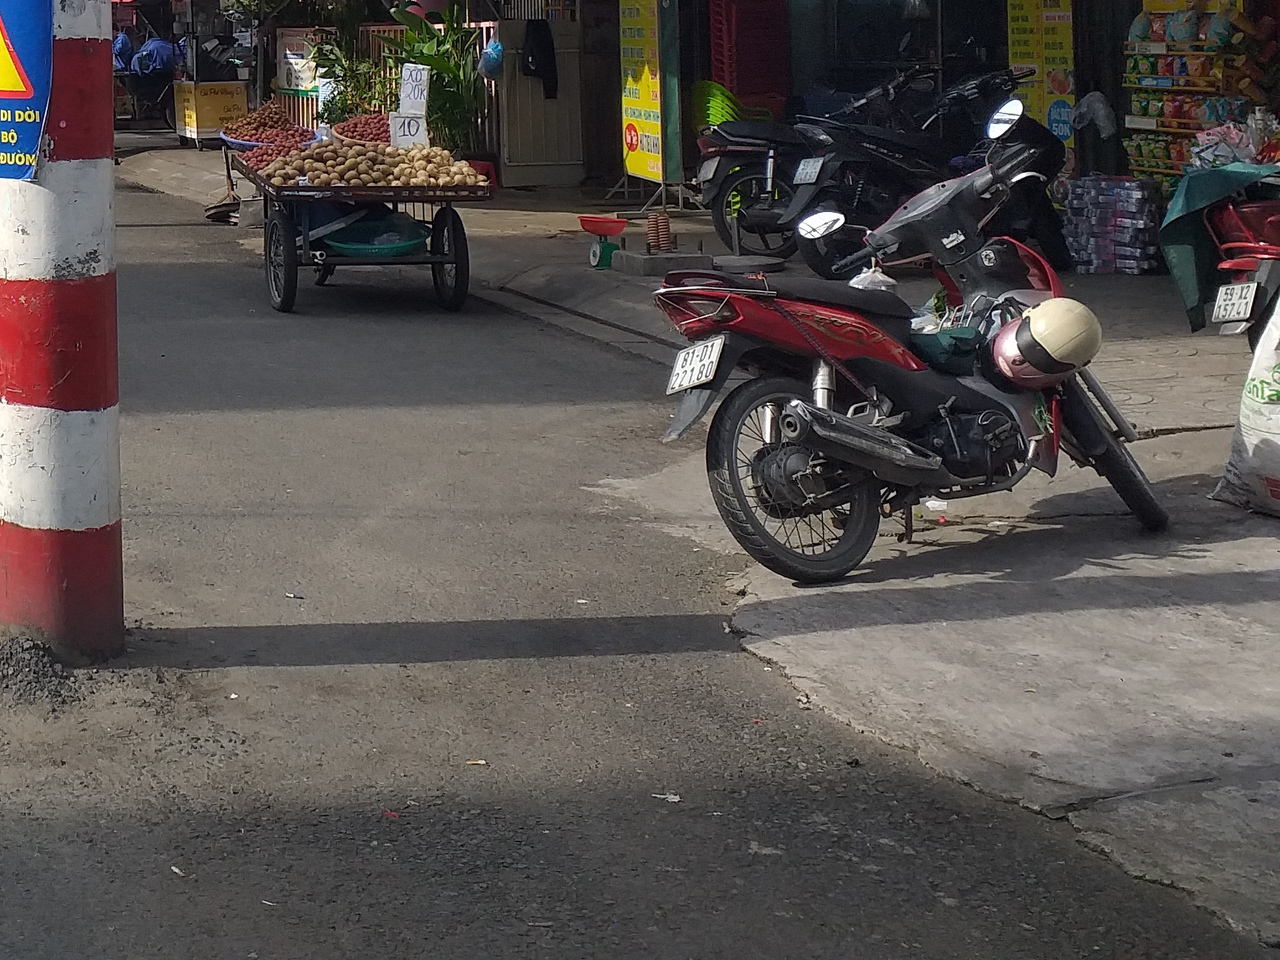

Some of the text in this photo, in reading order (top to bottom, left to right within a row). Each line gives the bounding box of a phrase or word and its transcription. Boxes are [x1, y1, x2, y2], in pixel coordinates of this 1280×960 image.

[0, 106, 41, 123] DI DỜI
[398, 119, 421, 137] 10
[1052, 123, 1071, 136] 50K
[1, 129, 18, 146] BỘ
[1222, 284, 1251, 302] 59-X2
[1216, 300, 1250, 319] 157.41
[681, 342, 715, 369] 81-D1
[671, 360, 714, 391] 221.80
